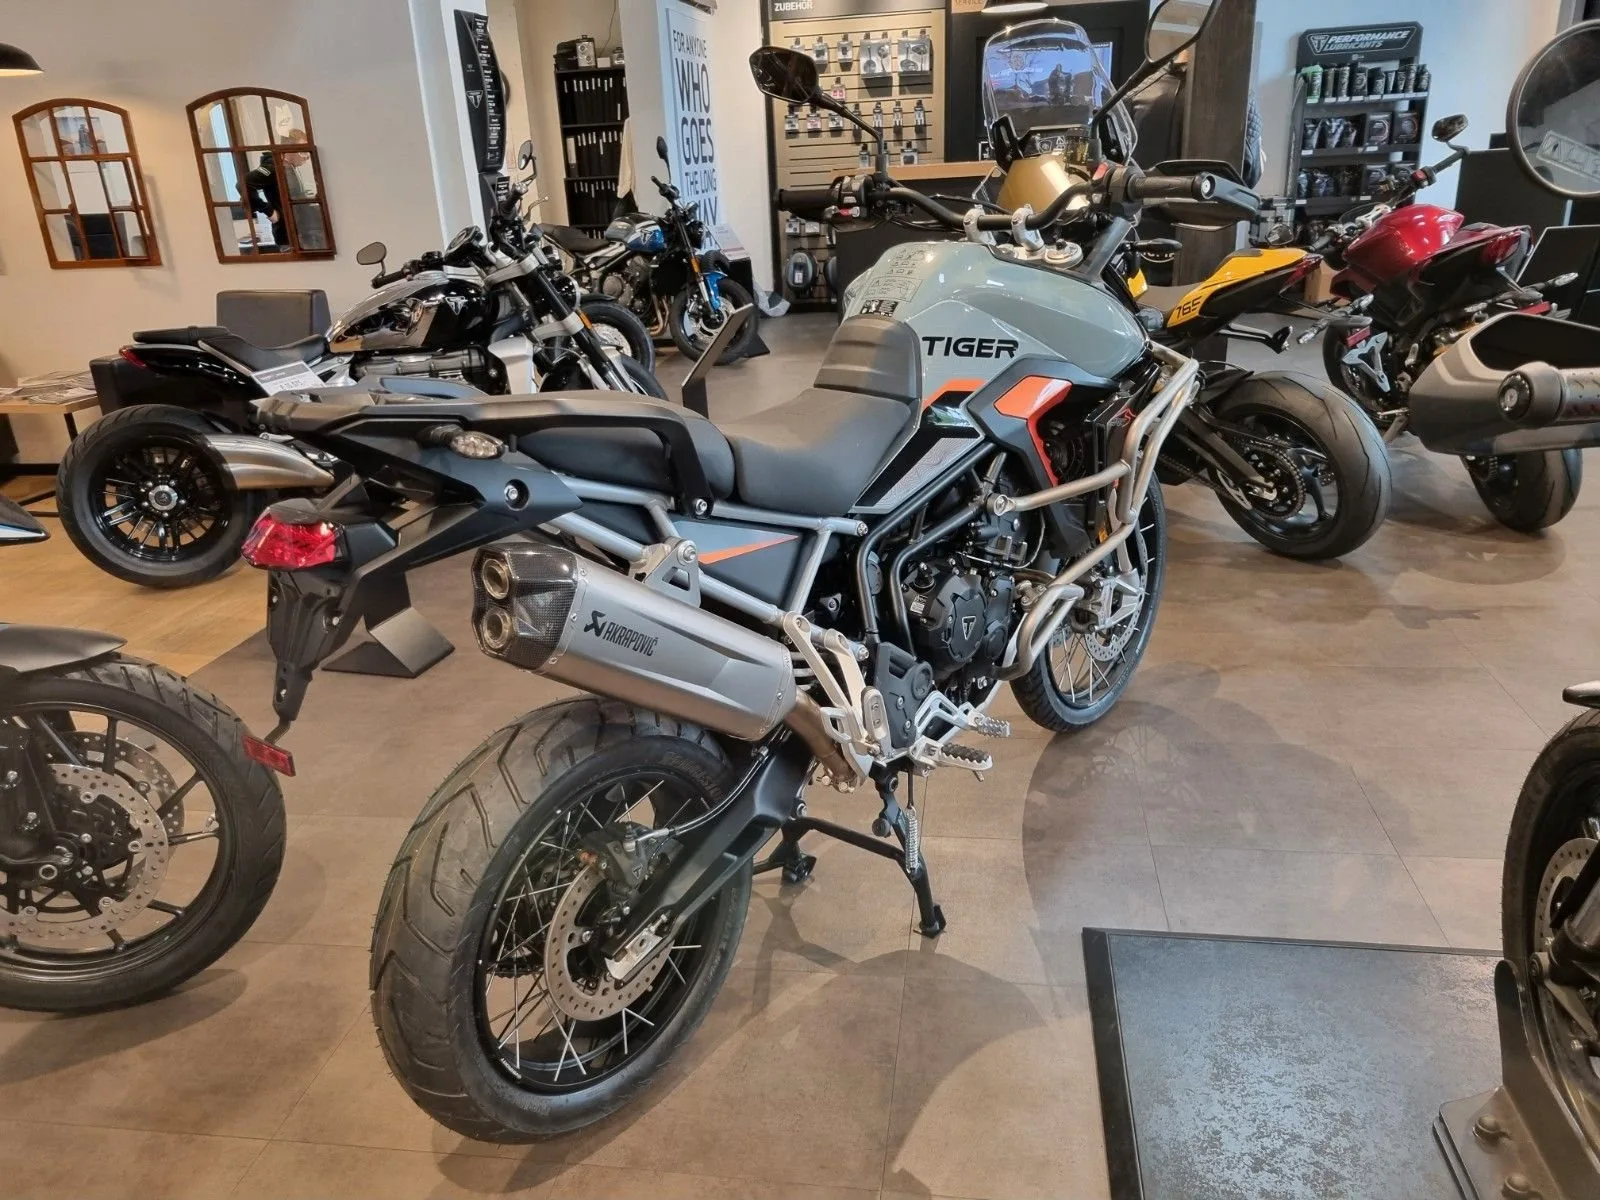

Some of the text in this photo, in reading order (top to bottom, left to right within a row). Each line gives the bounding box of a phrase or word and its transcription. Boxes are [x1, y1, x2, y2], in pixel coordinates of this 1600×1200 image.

[672, 29, 686, 53] FOR
[1322, 40, 1384, 52] LUBRICANTS
[1327, 30, 1411, 44] PERFORMANCE
[675, 57, 711, 114] WHO
[681, 116, 715, 166] GOES
[684, 168, 717, 197] THE LONG
[1176, 295, 1203, 321] 765
[921, 336, 1020, 359] TIGER
